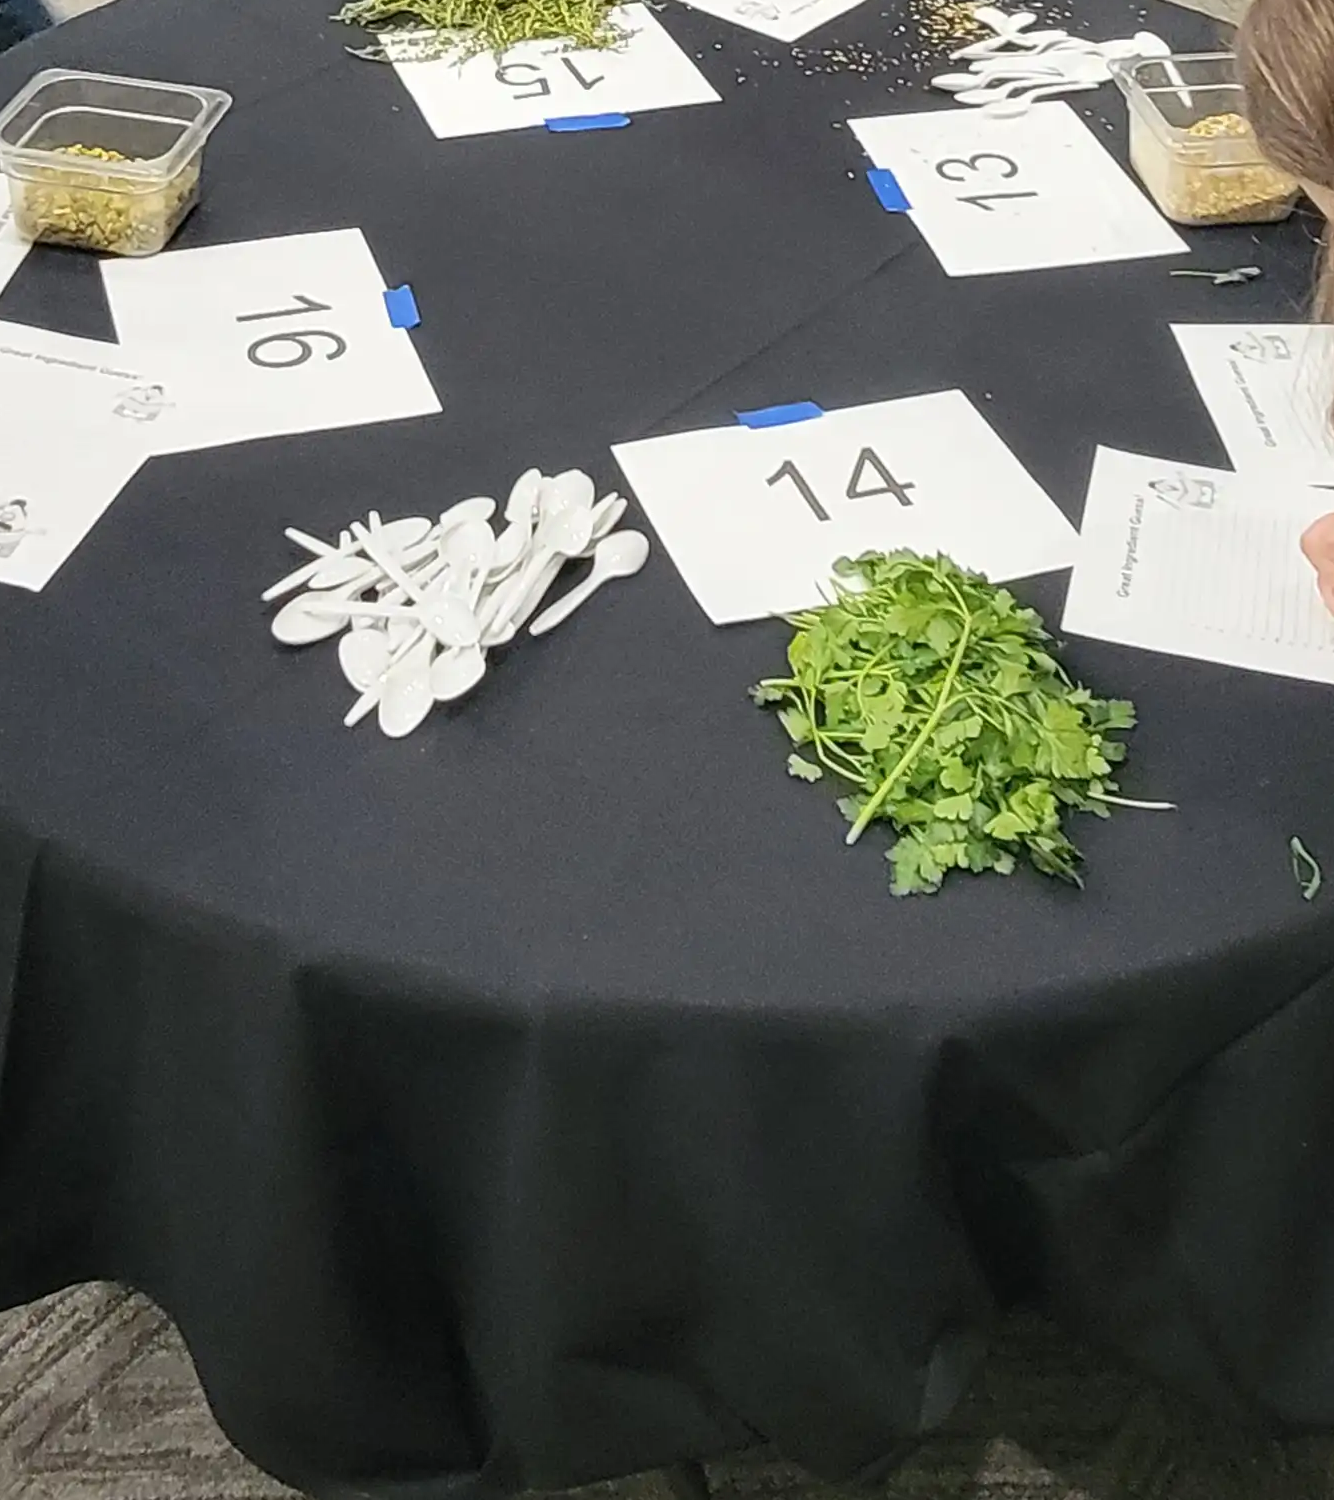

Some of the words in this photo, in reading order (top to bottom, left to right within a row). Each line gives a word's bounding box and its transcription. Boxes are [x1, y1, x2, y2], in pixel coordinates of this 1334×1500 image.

[495, 57, 605, 100] 15
[935, 153, 1039, 211] 13
[235, 294, 347, 368] 16
[765, 447, 915, 521] 14
[1121, 526, 1139, 571] Ingredient
[1116, 572, 1132, 598] Great
